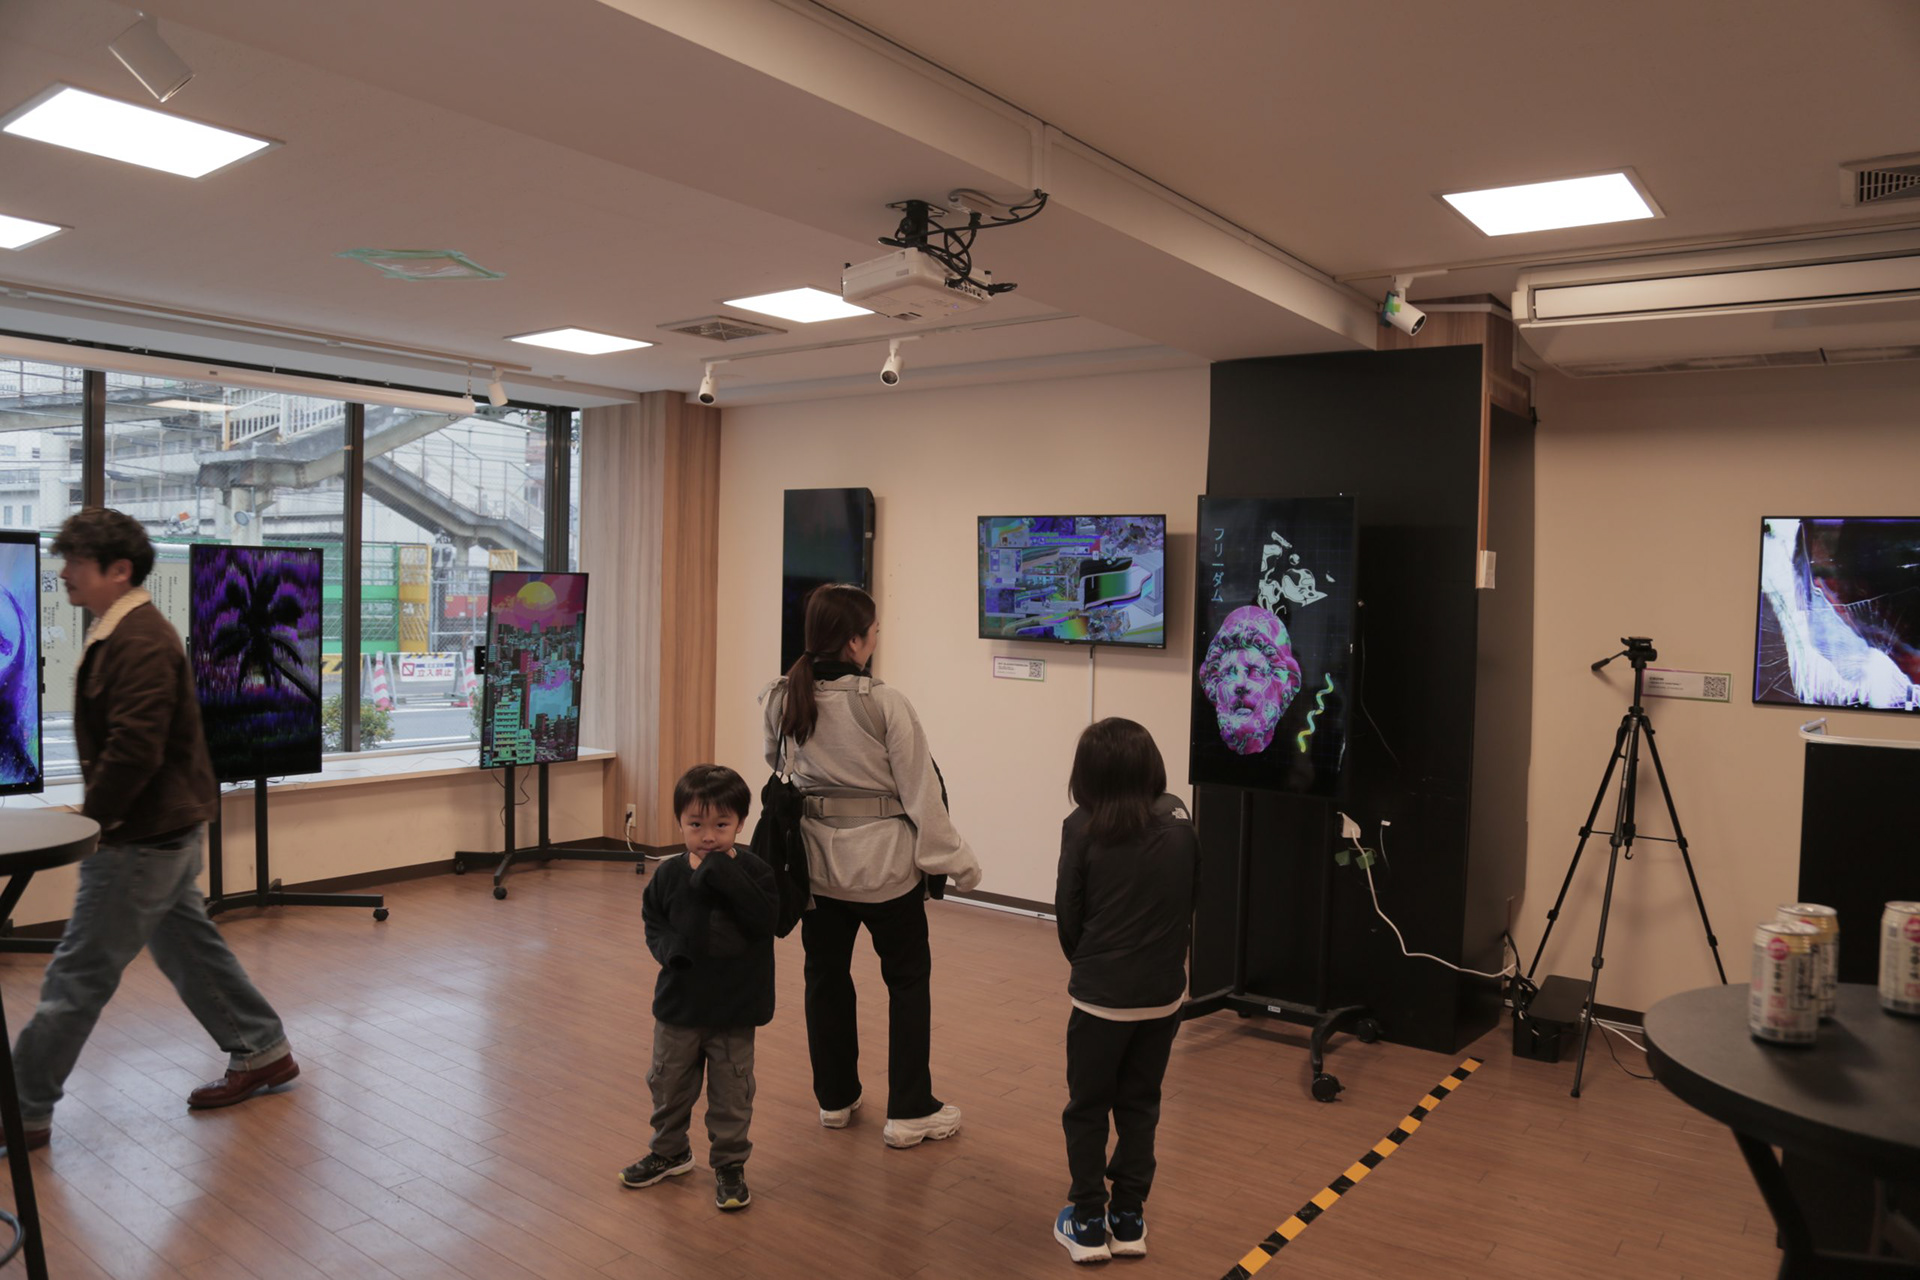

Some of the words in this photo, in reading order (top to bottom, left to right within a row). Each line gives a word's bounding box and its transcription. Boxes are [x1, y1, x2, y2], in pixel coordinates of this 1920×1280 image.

[1211, 528, 1225, 602] フリーダム
